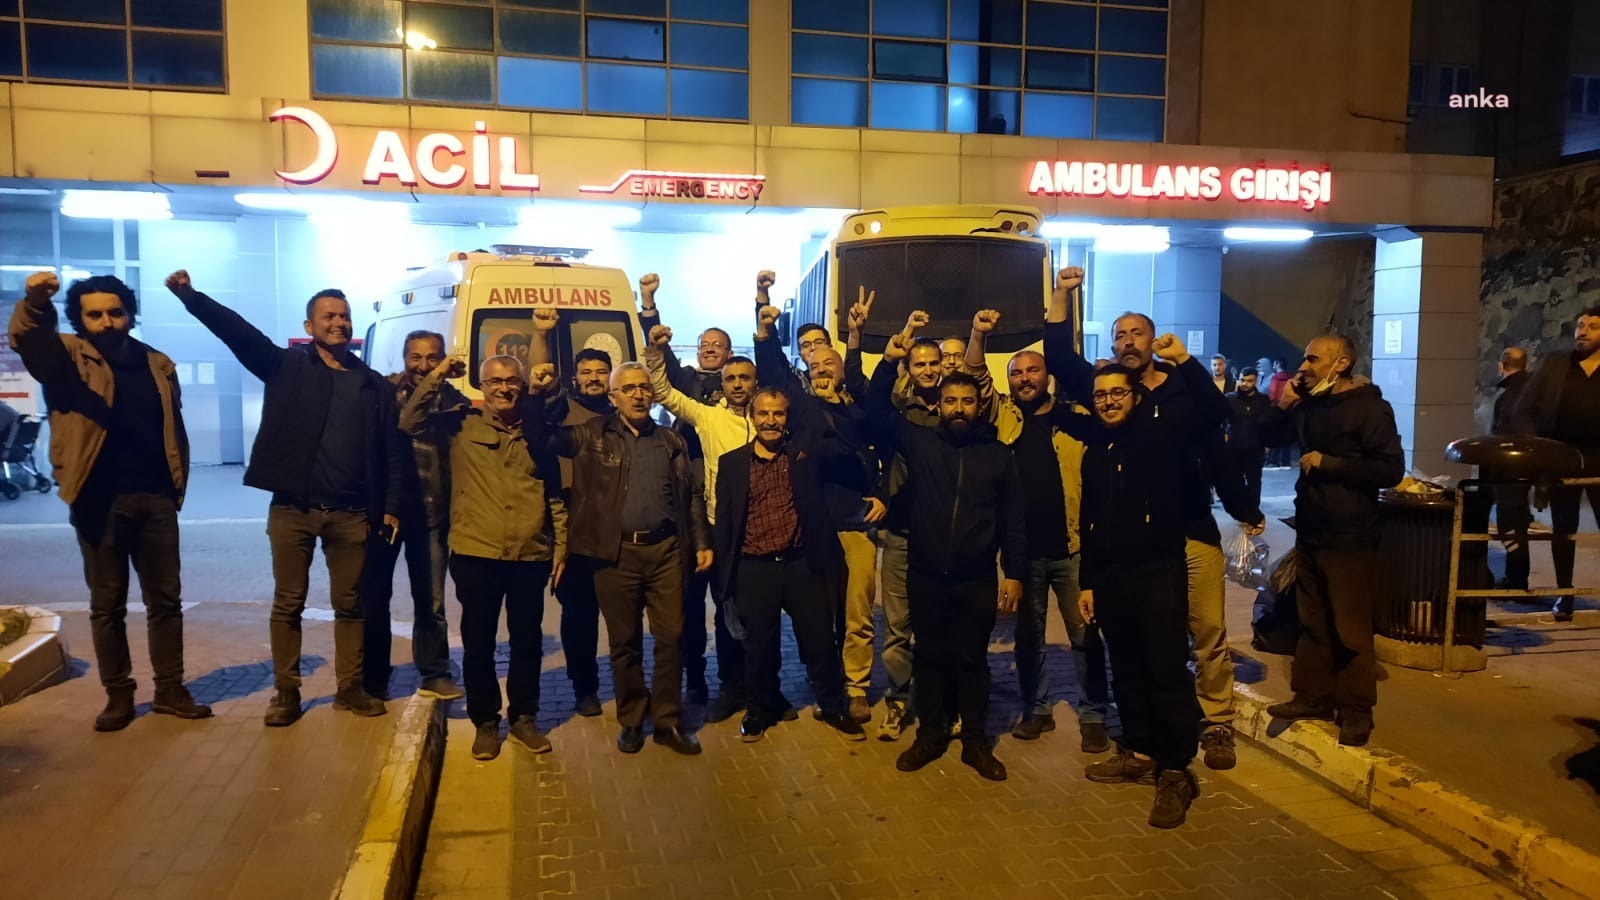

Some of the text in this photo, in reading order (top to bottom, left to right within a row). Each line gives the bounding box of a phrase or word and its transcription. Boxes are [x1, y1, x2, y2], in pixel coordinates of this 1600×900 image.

[362, 121, 540, 191] ACİL
[630, 178, 763, 200] EMERGENCY
[1028, 160, 1222, 199] AMBULANS
[487, 287, 613, 307] AMBULANS
